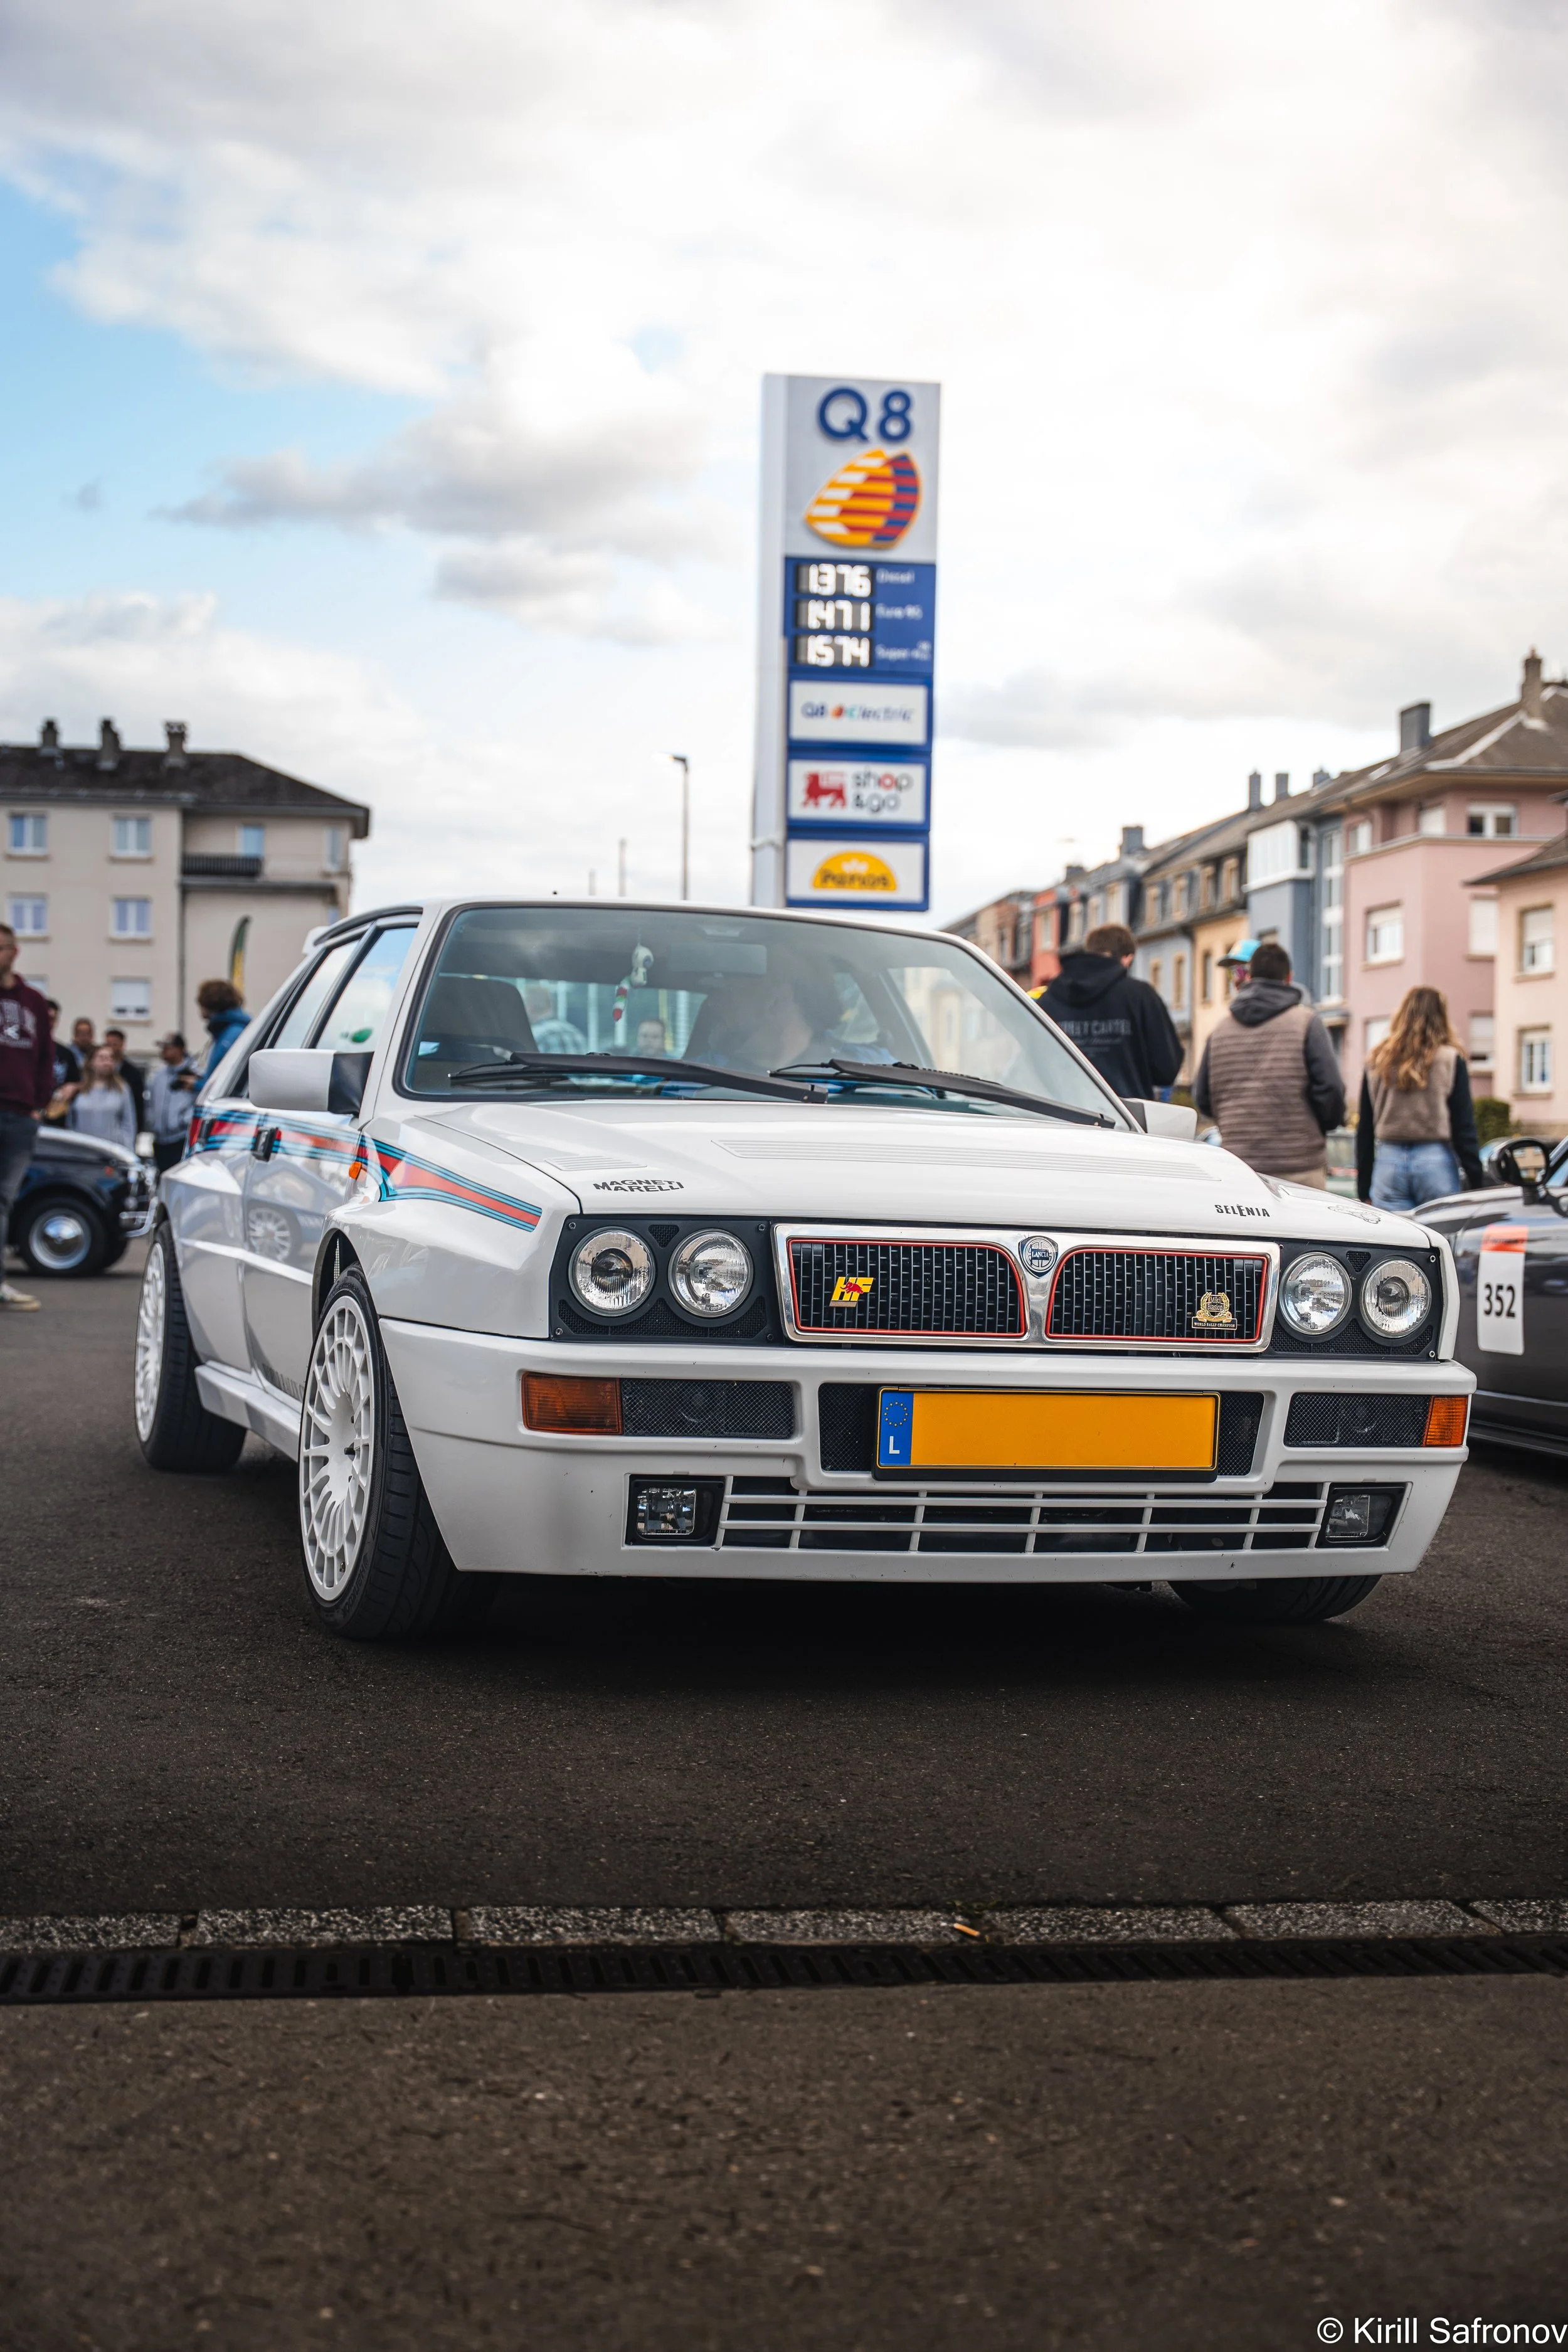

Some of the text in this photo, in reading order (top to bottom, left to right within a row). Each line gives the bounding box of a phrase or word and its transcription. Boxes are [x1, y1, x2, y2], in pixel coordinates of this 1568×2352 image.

[819, 387, 911, 443] Q8
[852, 767, 913, 792] shop
[831, 1276, 874, 1301] HF
[1484, 1283, 1516, 1318] 352
[889, 1436, 900, 1454] L
